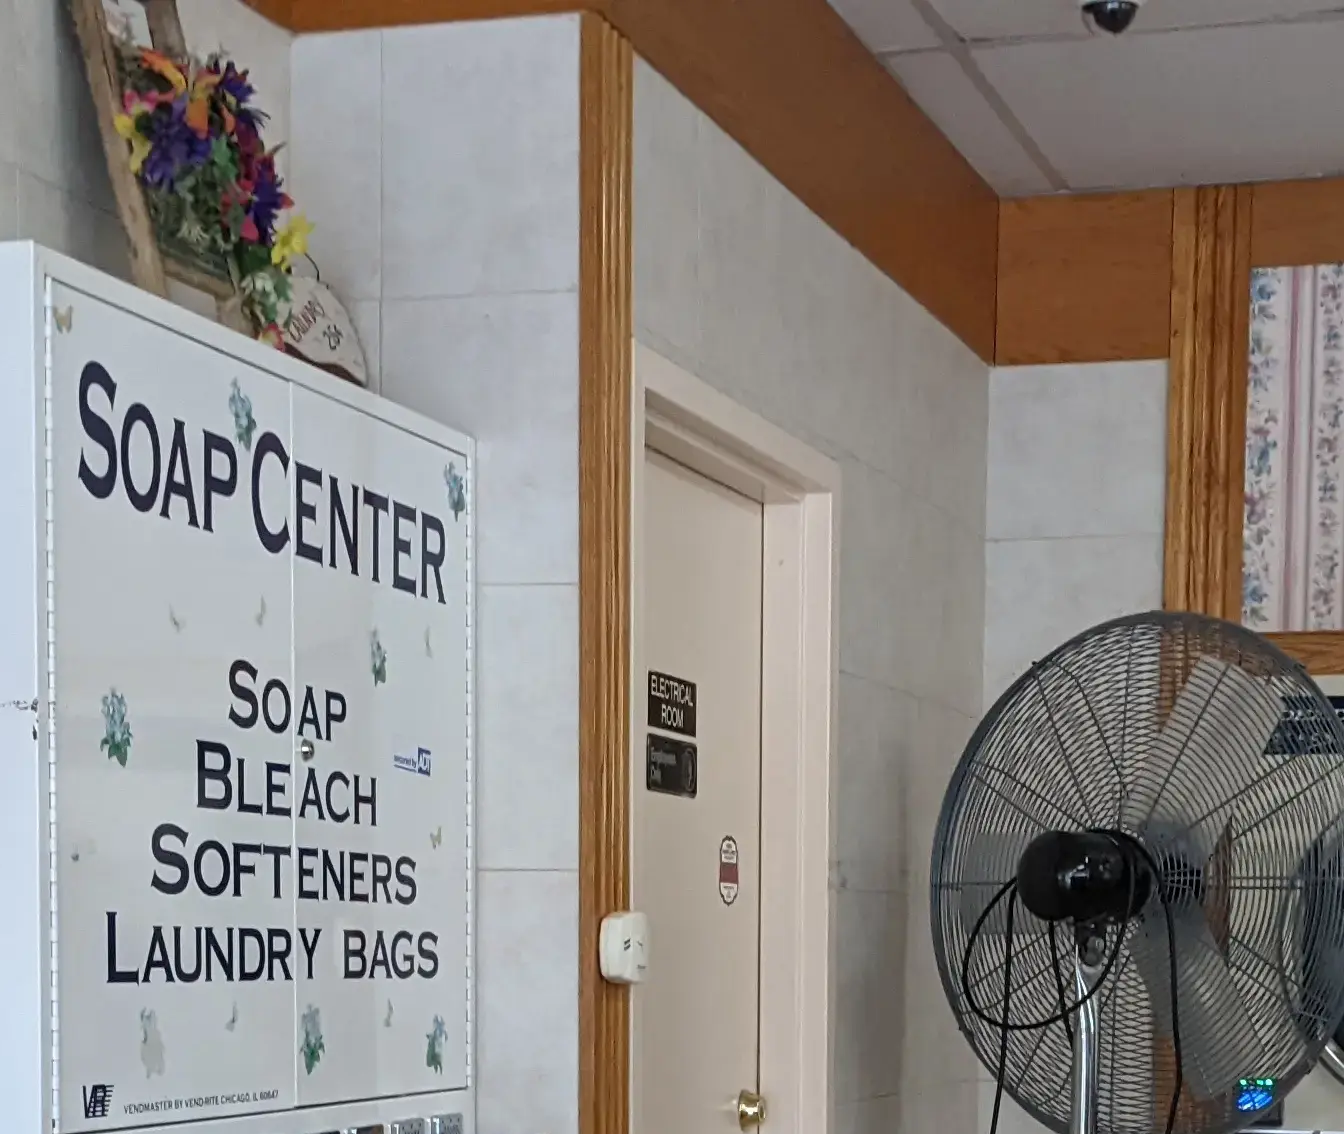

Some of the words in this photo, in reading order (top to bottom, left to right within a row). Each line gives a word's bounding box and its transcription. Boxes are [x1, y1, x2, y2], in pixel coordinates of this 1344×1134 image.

[77, 360, 238, 533] SOAP
[251, 430, 447, 606] CENTER
[228, 659, 347, 742] SOAP
[650, 674, 694, 707] ELECTRICAL
[661, 703, 684, 728] ROOM
[196, 739, 378, 827] BLEACH
[150, 822, 418, 905] SOFTENERS
[106, 911, 323, 986] LAUNDRY
[343, 929, 440, 980] BAGS
[123, 1099, 173, 1115] VENDMASTER
[174, 1098, 184, 1110] BY
